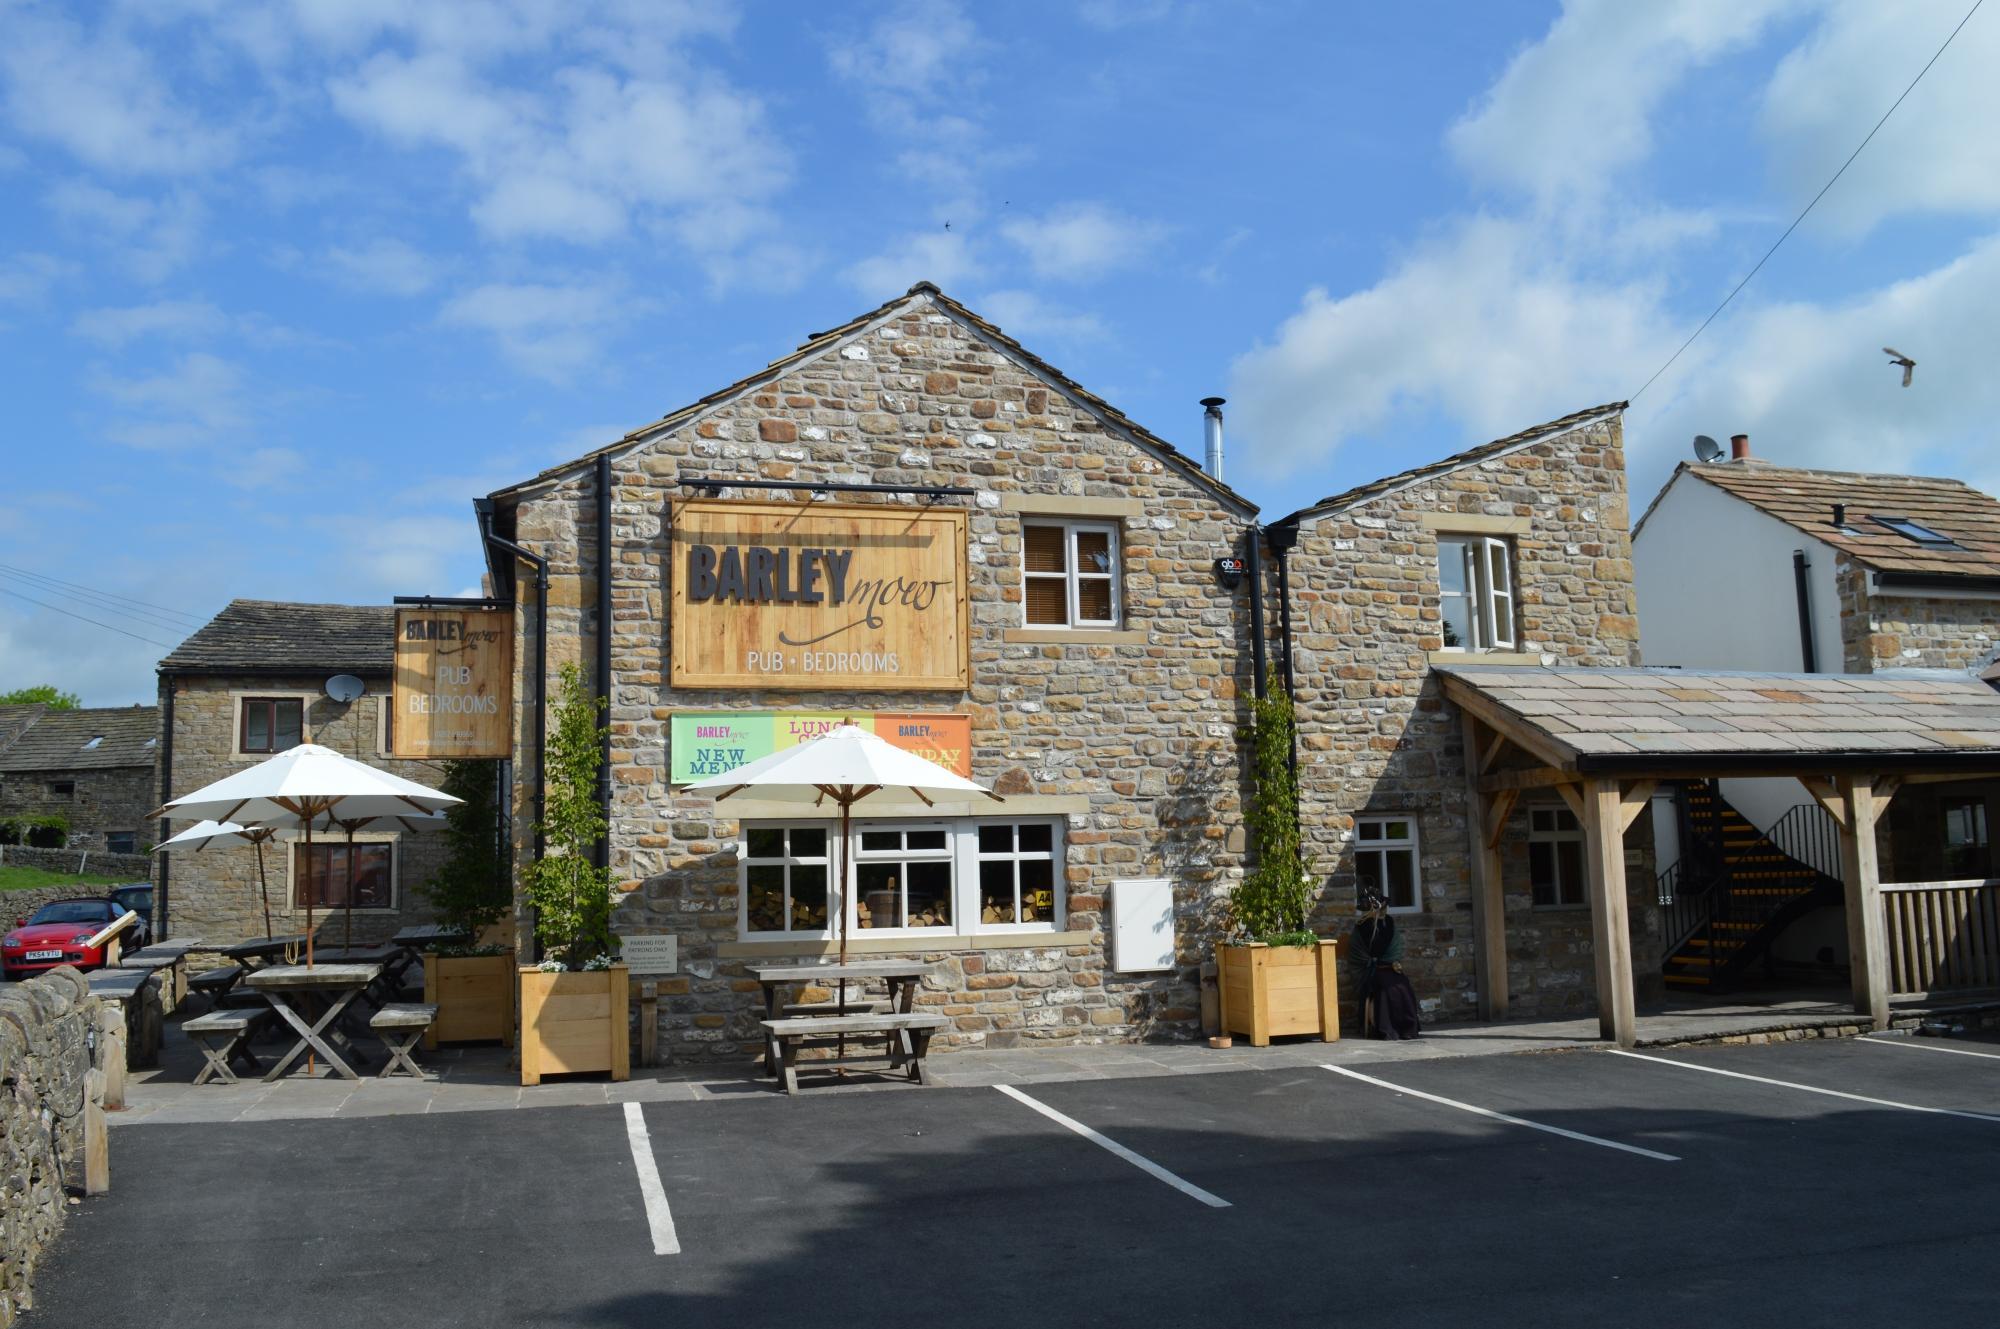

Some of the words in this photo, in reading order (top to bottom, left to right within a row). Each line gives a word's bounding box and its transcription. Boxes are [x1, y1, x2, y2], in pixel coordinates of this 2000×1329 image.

[690, 544, 852, 603] BARLEY
[406, 620, 465, 640] BARLEY
[748, 651, 783, 672] PUB
[803, 652, 899, 673] BEDROOMS
[439, 666, 471, 685] PUB
[409, 694, 497, 714] BEDROOMS
[696, 726, 730, 738] BARLEY
[899, 725, 930, 737] BARLEY
[696, 749, 745, 762] NEW
[689, 762, 751, 775] MEN
[1038, 892, 1051, 903] AA
